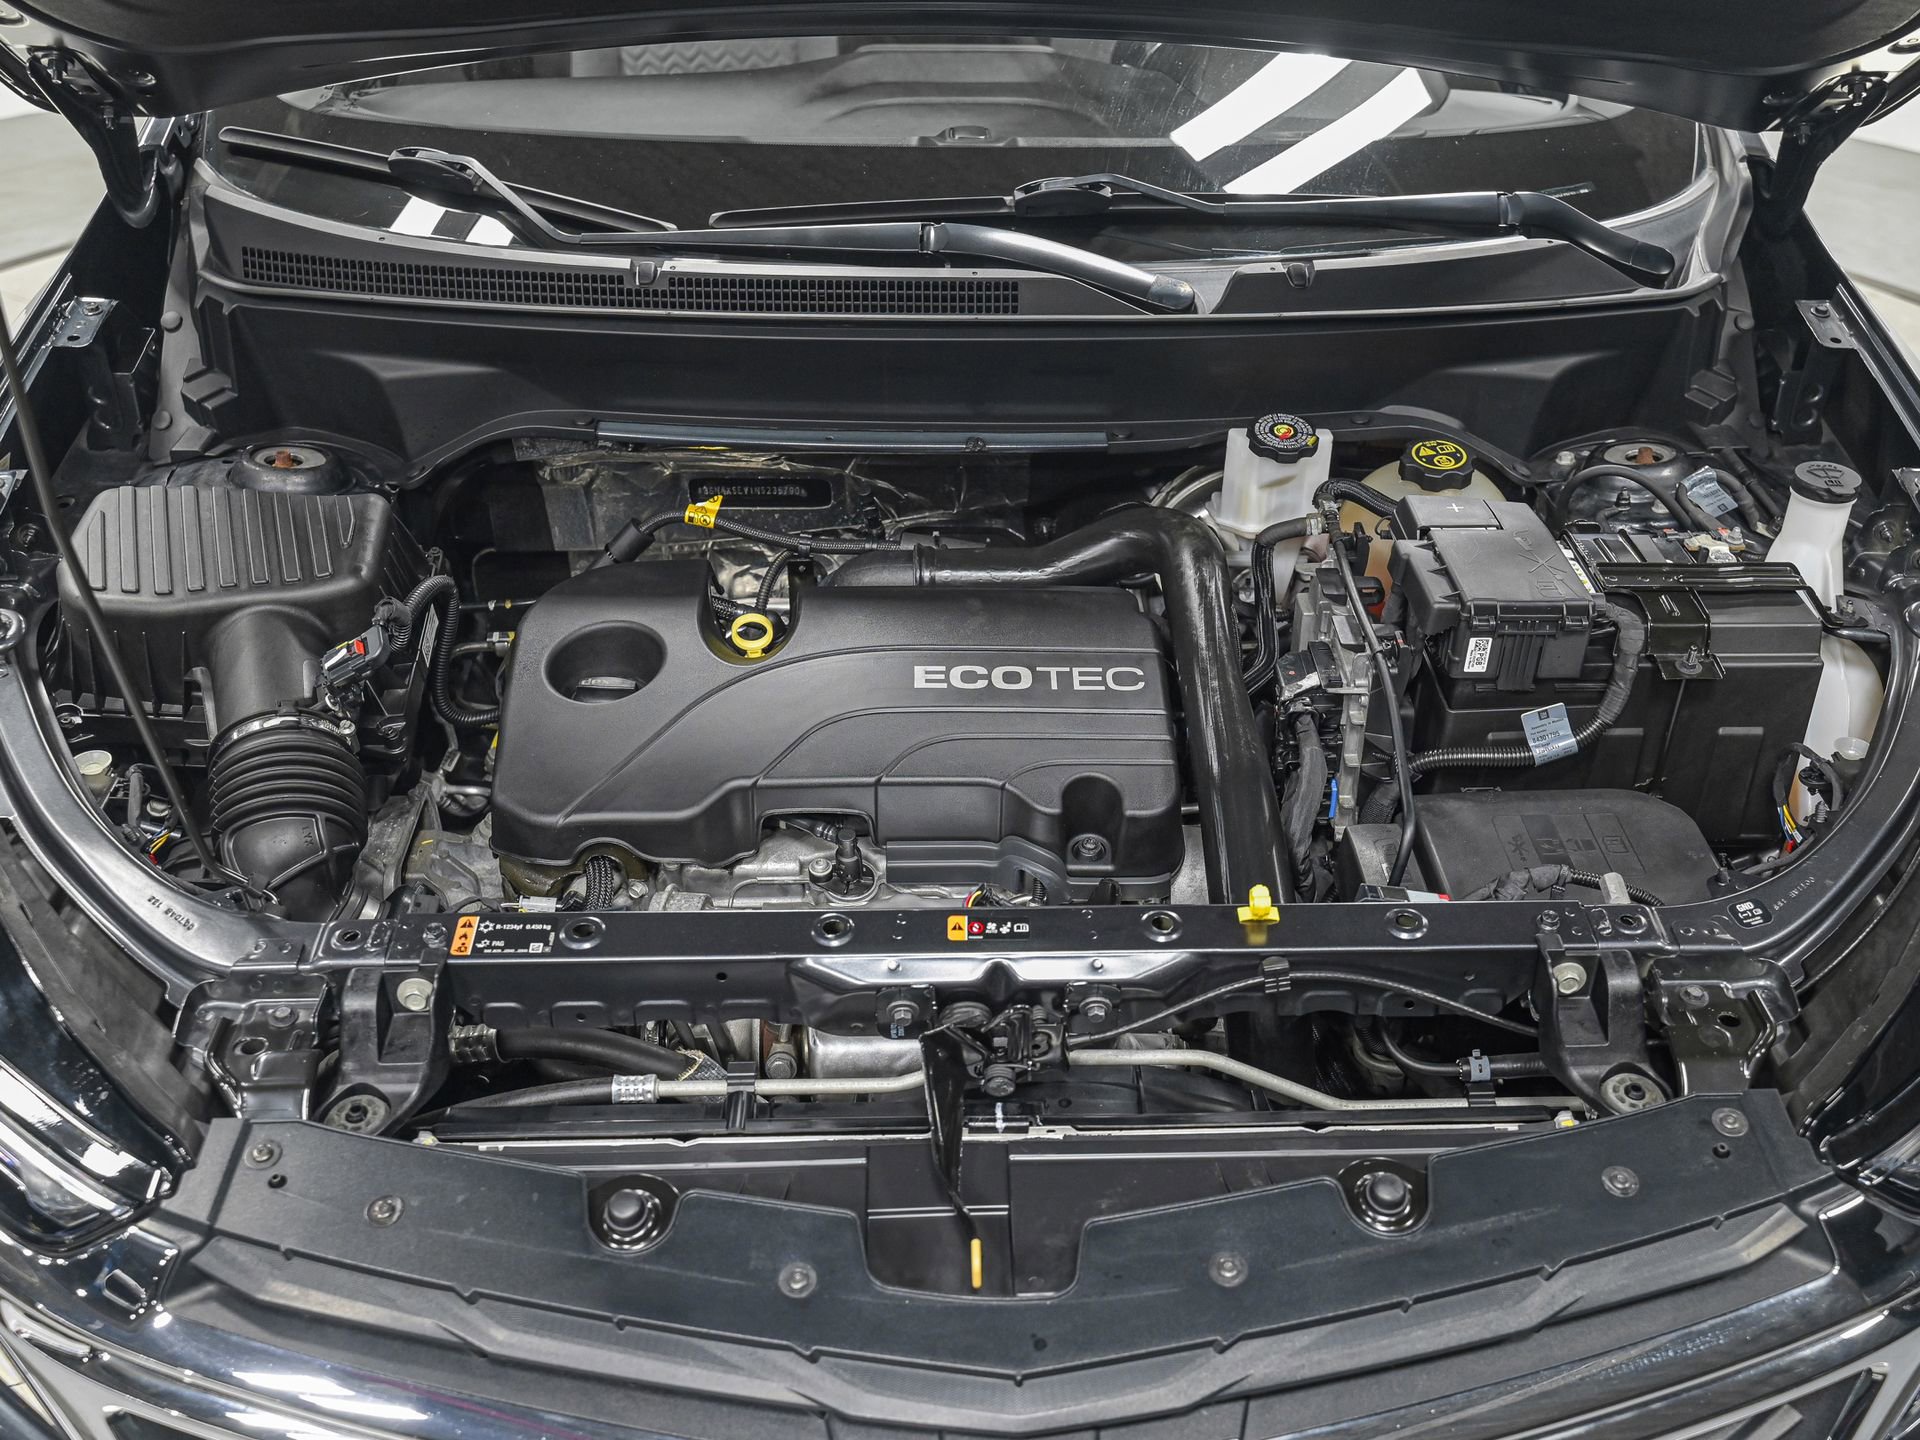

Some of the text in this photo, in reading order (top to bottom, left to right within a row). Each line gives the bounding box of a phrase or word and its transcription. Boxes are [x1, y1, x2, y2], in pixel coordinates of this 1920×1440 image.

[1475, 652, 1484, 665] PGB
[914, 665, 1145, 691] ECOTEC
[1736, 901, 1755, 912] GND
